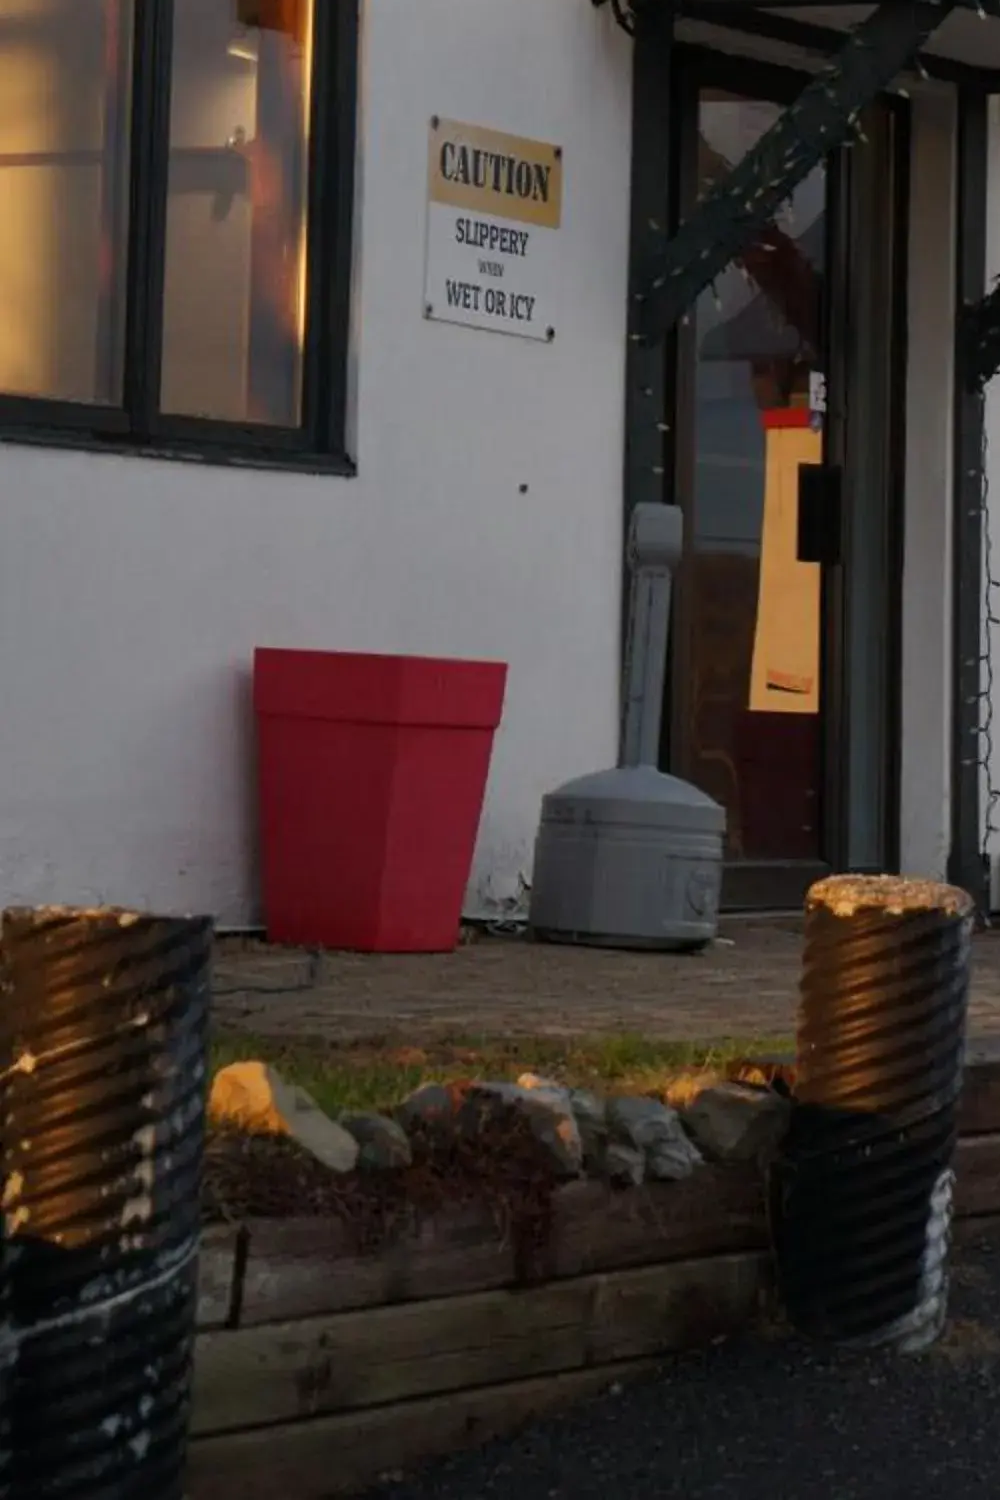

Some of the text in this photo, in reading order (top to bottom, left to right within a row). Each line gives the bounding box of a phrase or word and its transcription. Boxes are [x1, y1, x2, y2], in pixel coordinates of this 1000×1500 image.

[440, 141, 551, 203] CAUTION
[455, 217, 529, 257] SLIPPERY
[445, 279, 536, 322] WET OR ICY
